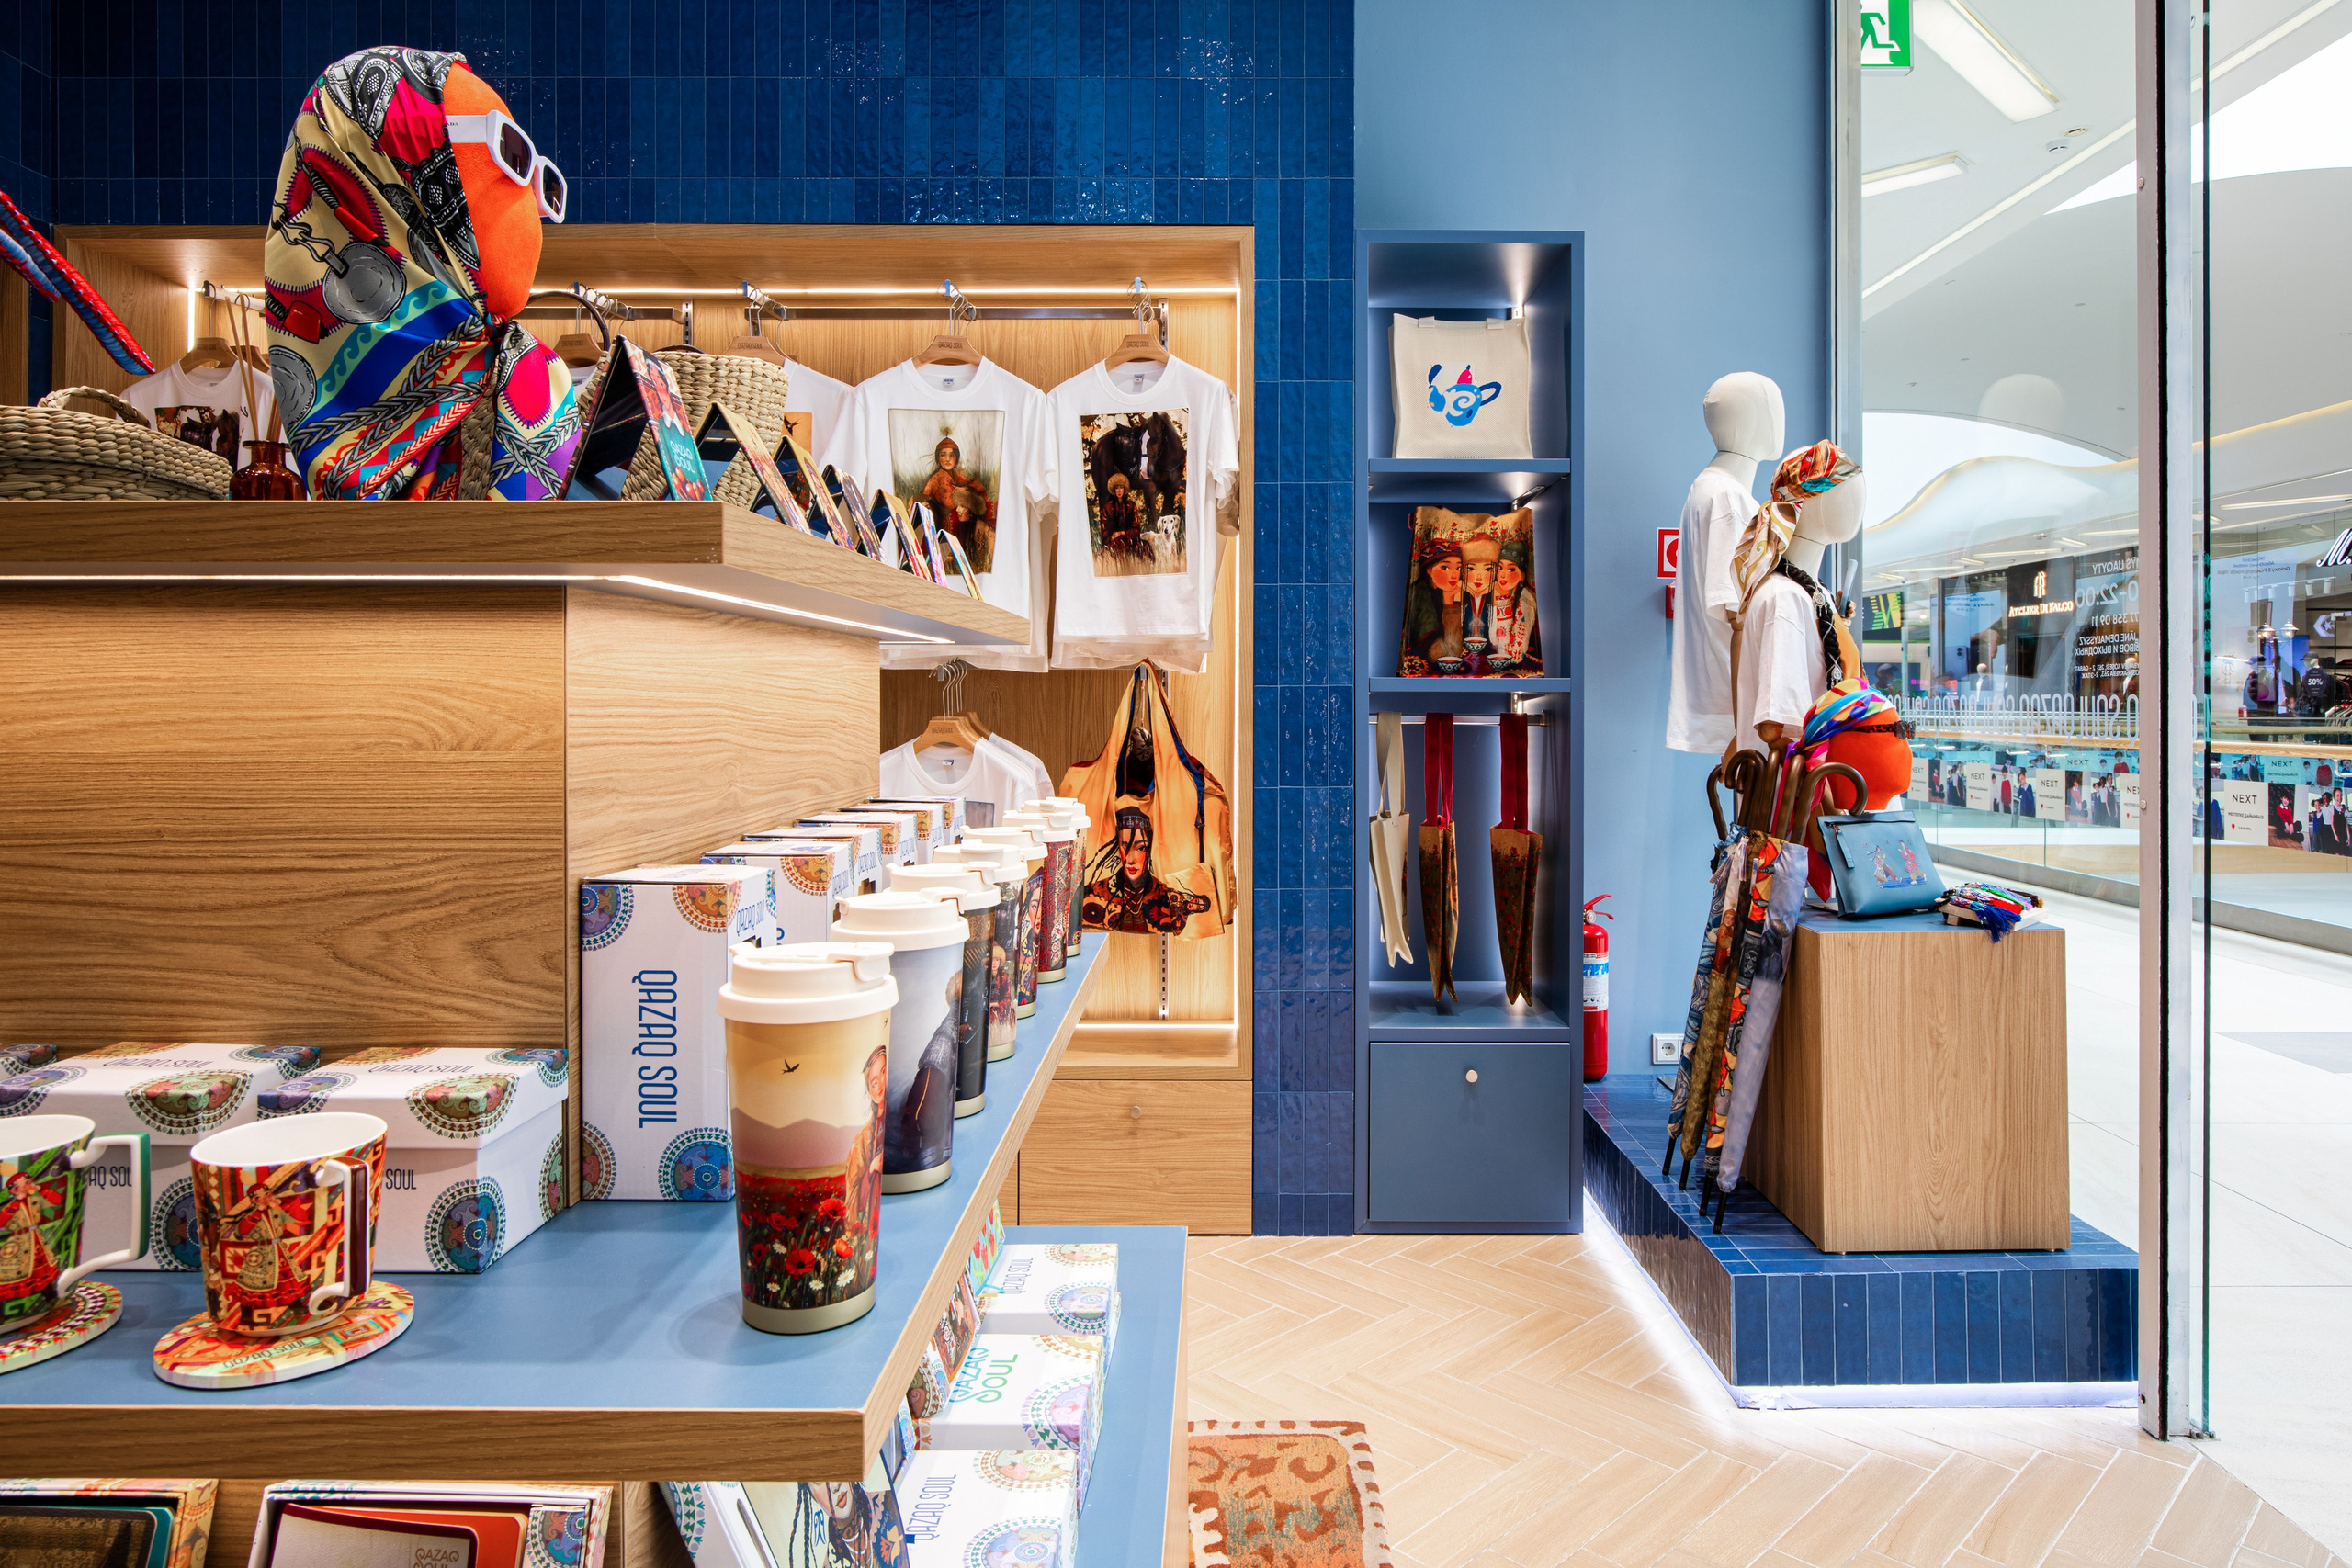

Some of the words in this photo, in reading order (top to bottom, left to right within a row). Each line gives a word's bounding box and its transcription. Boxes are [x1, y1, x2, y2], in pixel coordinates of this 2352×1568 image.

[1971, 773, 1985, 781] NEXT
[2041, 780, 2058, 788] NEXT
[2233, 794, 2257, 804] NEXT
[736, 904, 756, 936] QAZAQ
[632, 970, 678, 1057] QAZAQ
[103, 1058, 170, 1067] QAZAQ
[165, 1059, 213, 1068] SOUL
[368, 1065, 434, 1073] QAZAQ
[638, 1066, 678, 1128] SOUL
[385, 1168, 416, 1190] SOUL
[1008, 1258, 1033, 1272] SOUL
[223, 1350, 272, 1368] QAZAQ
[274, 1340, 307, 1353] SOUL
[949, 1348, 989, 1403] QAZAQ
[976, 1354, 1018, 1403] SOUL
[919, 1474, 956, 1499] SOUL
[906, 1503, 951, 1540] QAZAQ
[415, 1548, 459, 1562] QAZAQ
